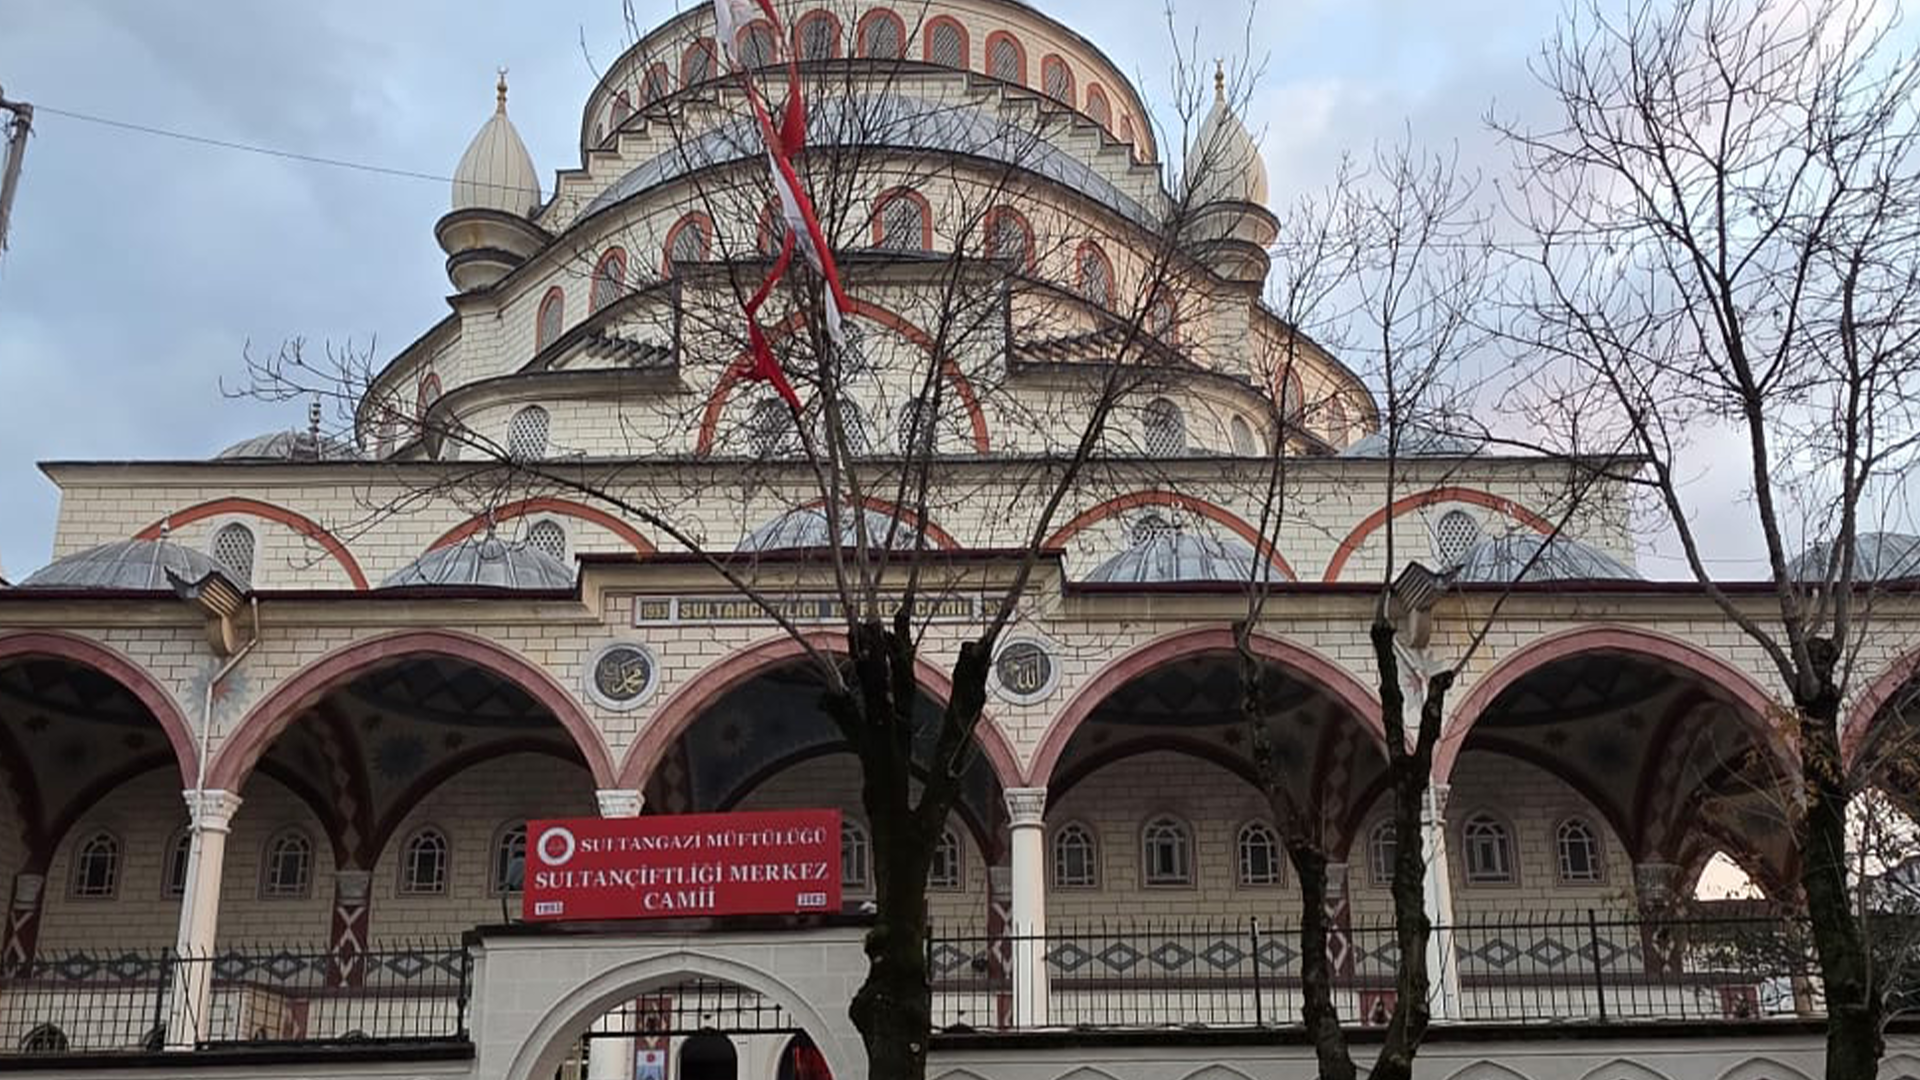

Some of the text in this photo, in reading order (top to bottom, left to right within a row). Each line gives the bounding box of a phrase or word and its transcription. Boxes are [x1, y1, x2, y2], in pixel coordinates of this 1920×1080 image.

[534, 861, 829, 889] SULTANÇİFTLİĞİ MERKEZ
[643, 886, 716, 910] CAMİİ
